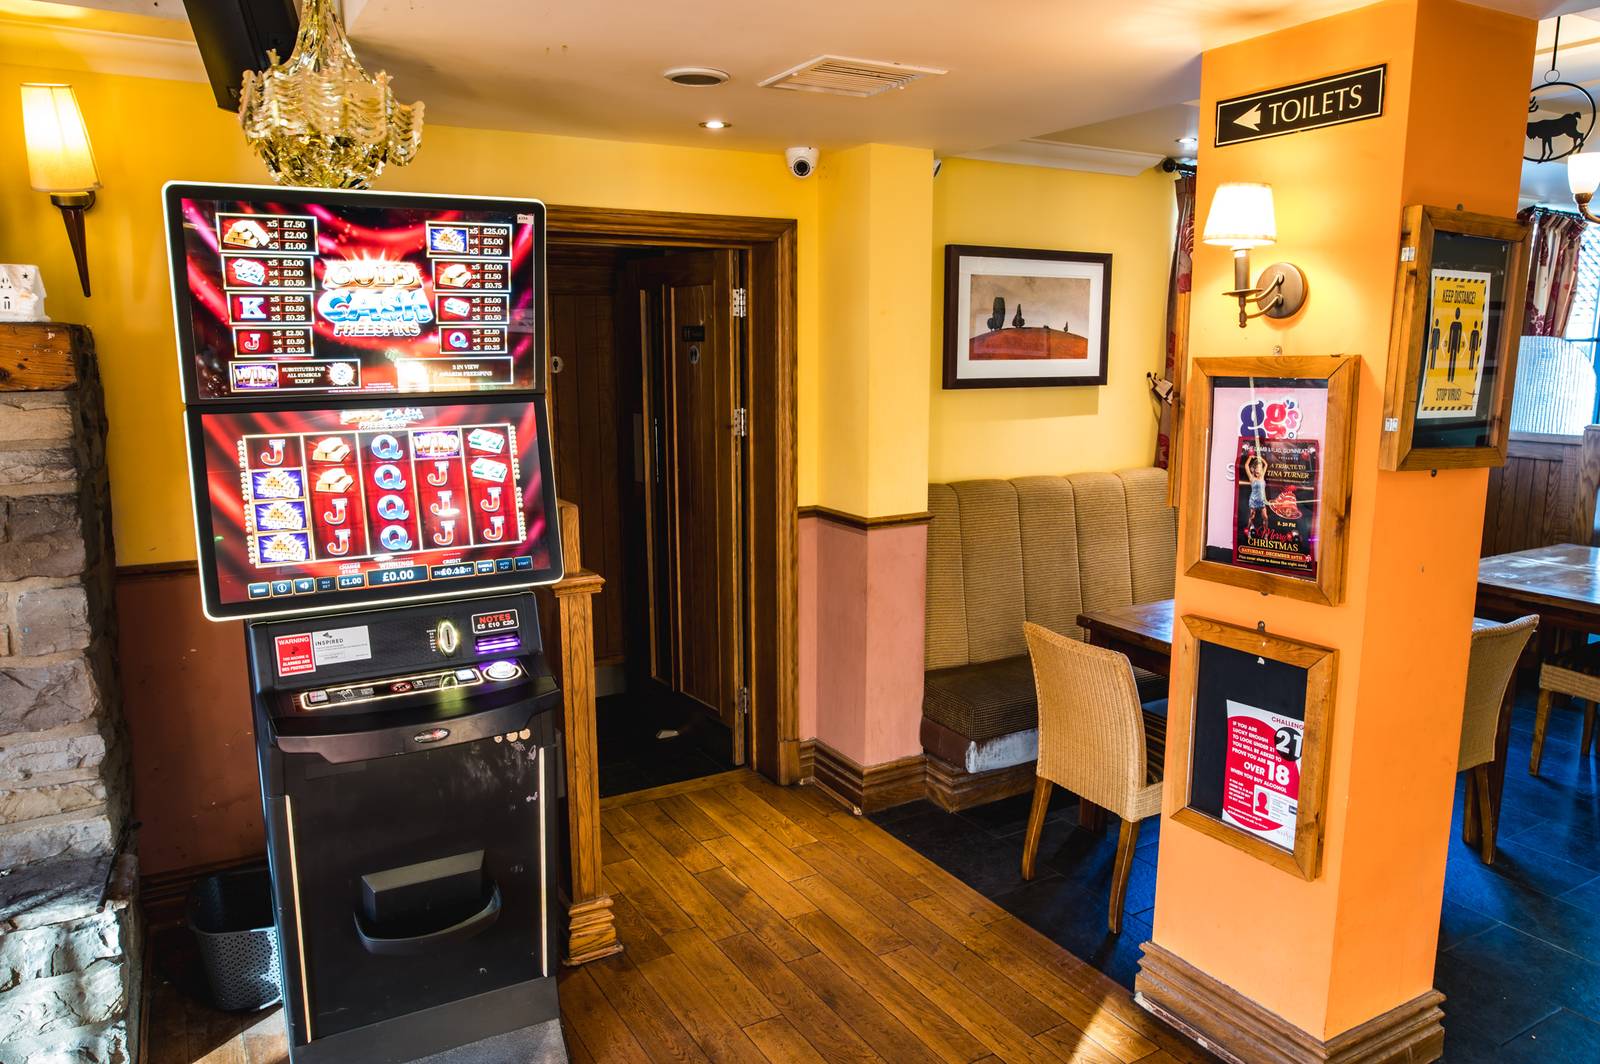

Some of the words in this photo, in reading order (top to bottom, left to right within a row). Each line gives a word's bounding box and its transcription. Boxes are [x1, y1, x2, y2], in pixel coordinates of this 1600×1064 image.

[1269, 85, 1362, 124] TOILETS
[239, 297, 266, 319] K
[319, 292, 434, 323] CASH
[1442, 289, 1454, 303] KEEP
[1454, 290, 1476, 304] DISTANCE!
[334, 323, 421, 336] FREESPINS
[449, 331, 469, 348] Q
[244, 333, 260, 350] J
[234, 366, 278, 385] WILD
[1436, 388, 1447, 401] STOP
[1448, 388, 1462, 401] VIRUS!
[261, 439, 285, 466] J
[371, 434, 403, 459] Q
[374, 464, 406, 490] Q
[427, 461, 449, 486] J
[324, 498, 347, 524] J
[377, 495, 409, 520] Q
[430, 490, 453, 517] J
[480, 487, 501, 512] J
[380, 525, 412, 550] Q
[433, 520, 455, 545] J
[483, 516, 505, 540] J
[327, 528, 351, 555] J
[1247, 538, 1299, 552] CHRISTMAS
[1266, 551, 1290, 559] DECEMBER
[341, 577, 362, 585] £1.00
[383, 570, 414, 582] £0.00
[479, 613, 511, 623] NOTES
[278, 637, 309, 645] WARNING
[1233, 727, 1247, 735] LUCKY
[1249, 733, 1268, 743] ENOUGH
[1240, 736, 1252, 744] LOOK
[1253, 741, 1268, 750] UNDER
[1276, 730, 1302, 758] 21
[1232, 740, 1242, 748] YOU
[1243, 744, 1253, 752] WILL
[1260, 750, 1274, 759] ASKED
[1232, 747, 1246, 756] PROVE
[1257, 756, 1266, 764] ARE
[1230, 767, 1243, 776] WHEN
[1244, 772, 1253, 780] YOU
[1264, 781, 1287, 793] ALCOHOL
[1244, 762, 1265, 776] OVER
[1267, 760, 1289, 786] 18
